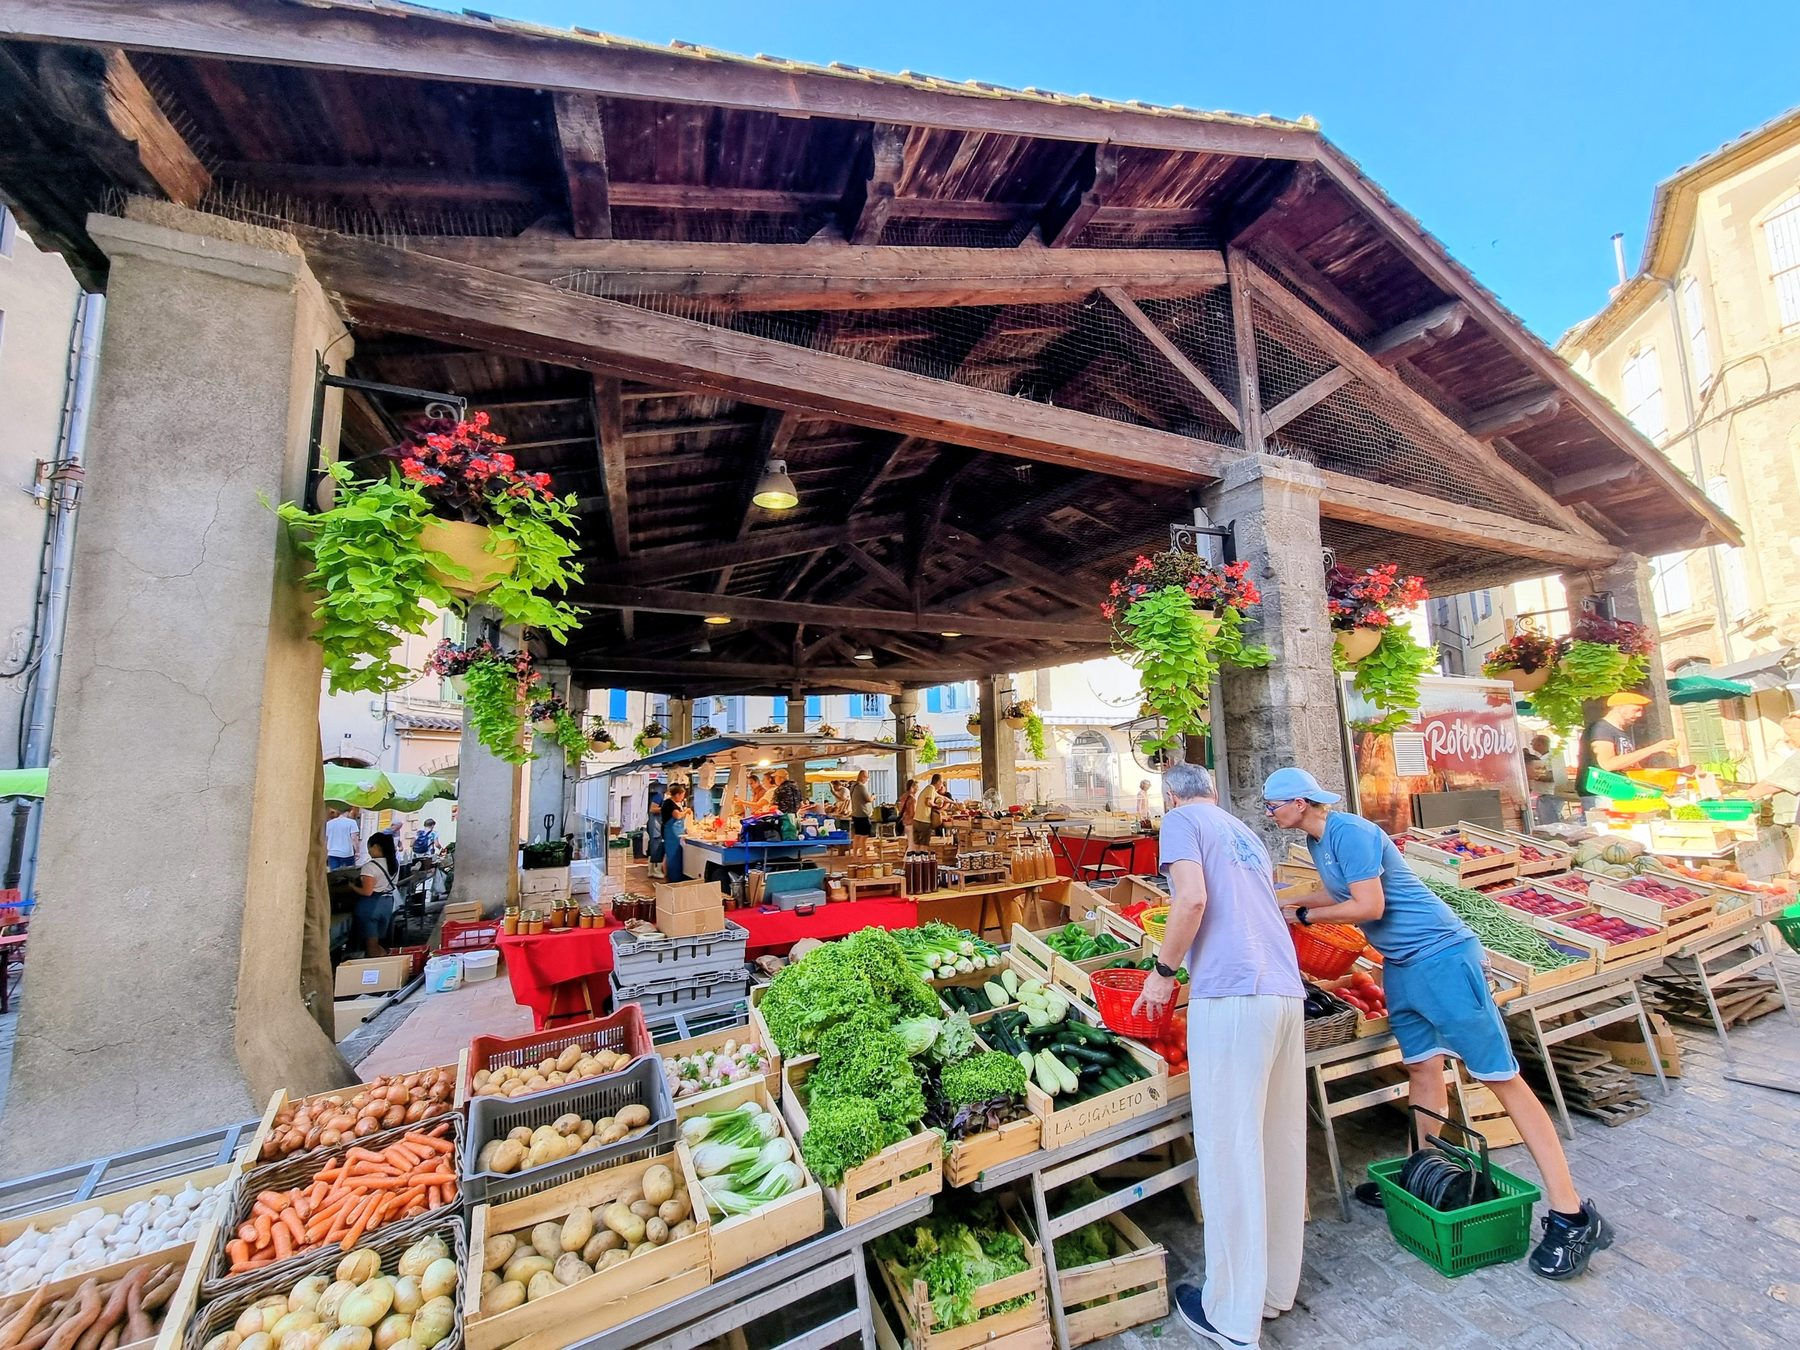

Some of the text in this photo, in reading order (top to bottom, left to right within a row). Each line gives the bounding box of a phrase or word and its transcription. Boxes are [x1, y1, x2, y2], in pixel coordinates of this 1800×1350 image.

[1425, 718, 1516, 762] Rotisserie
[1055, 1092, 1143, 1135] LA CIGALETO
